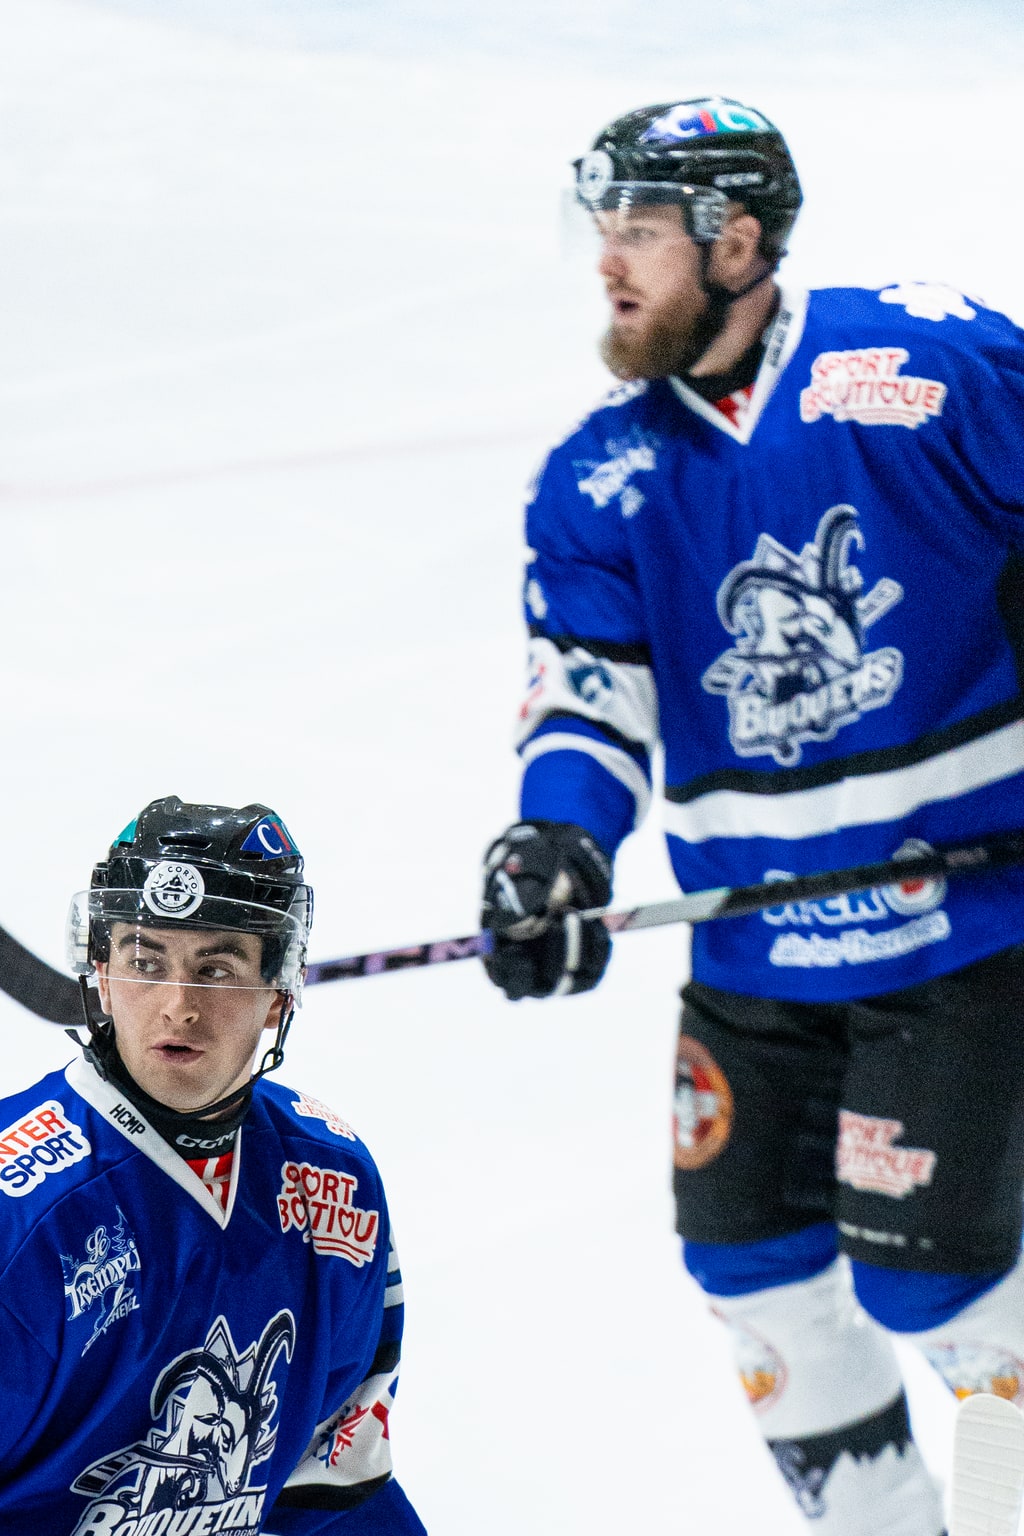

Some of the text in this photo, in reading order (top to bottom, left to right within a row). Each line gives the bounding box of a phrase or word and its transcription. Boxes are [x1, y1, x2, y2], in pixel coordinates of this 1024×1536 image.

[167, 866, 198, 889] CORTO
[109, 1103, 146, 1135] HCMP
[176, 1129, 236, 1149] CCM
[0, 1130, 84, 1189] SPORT
